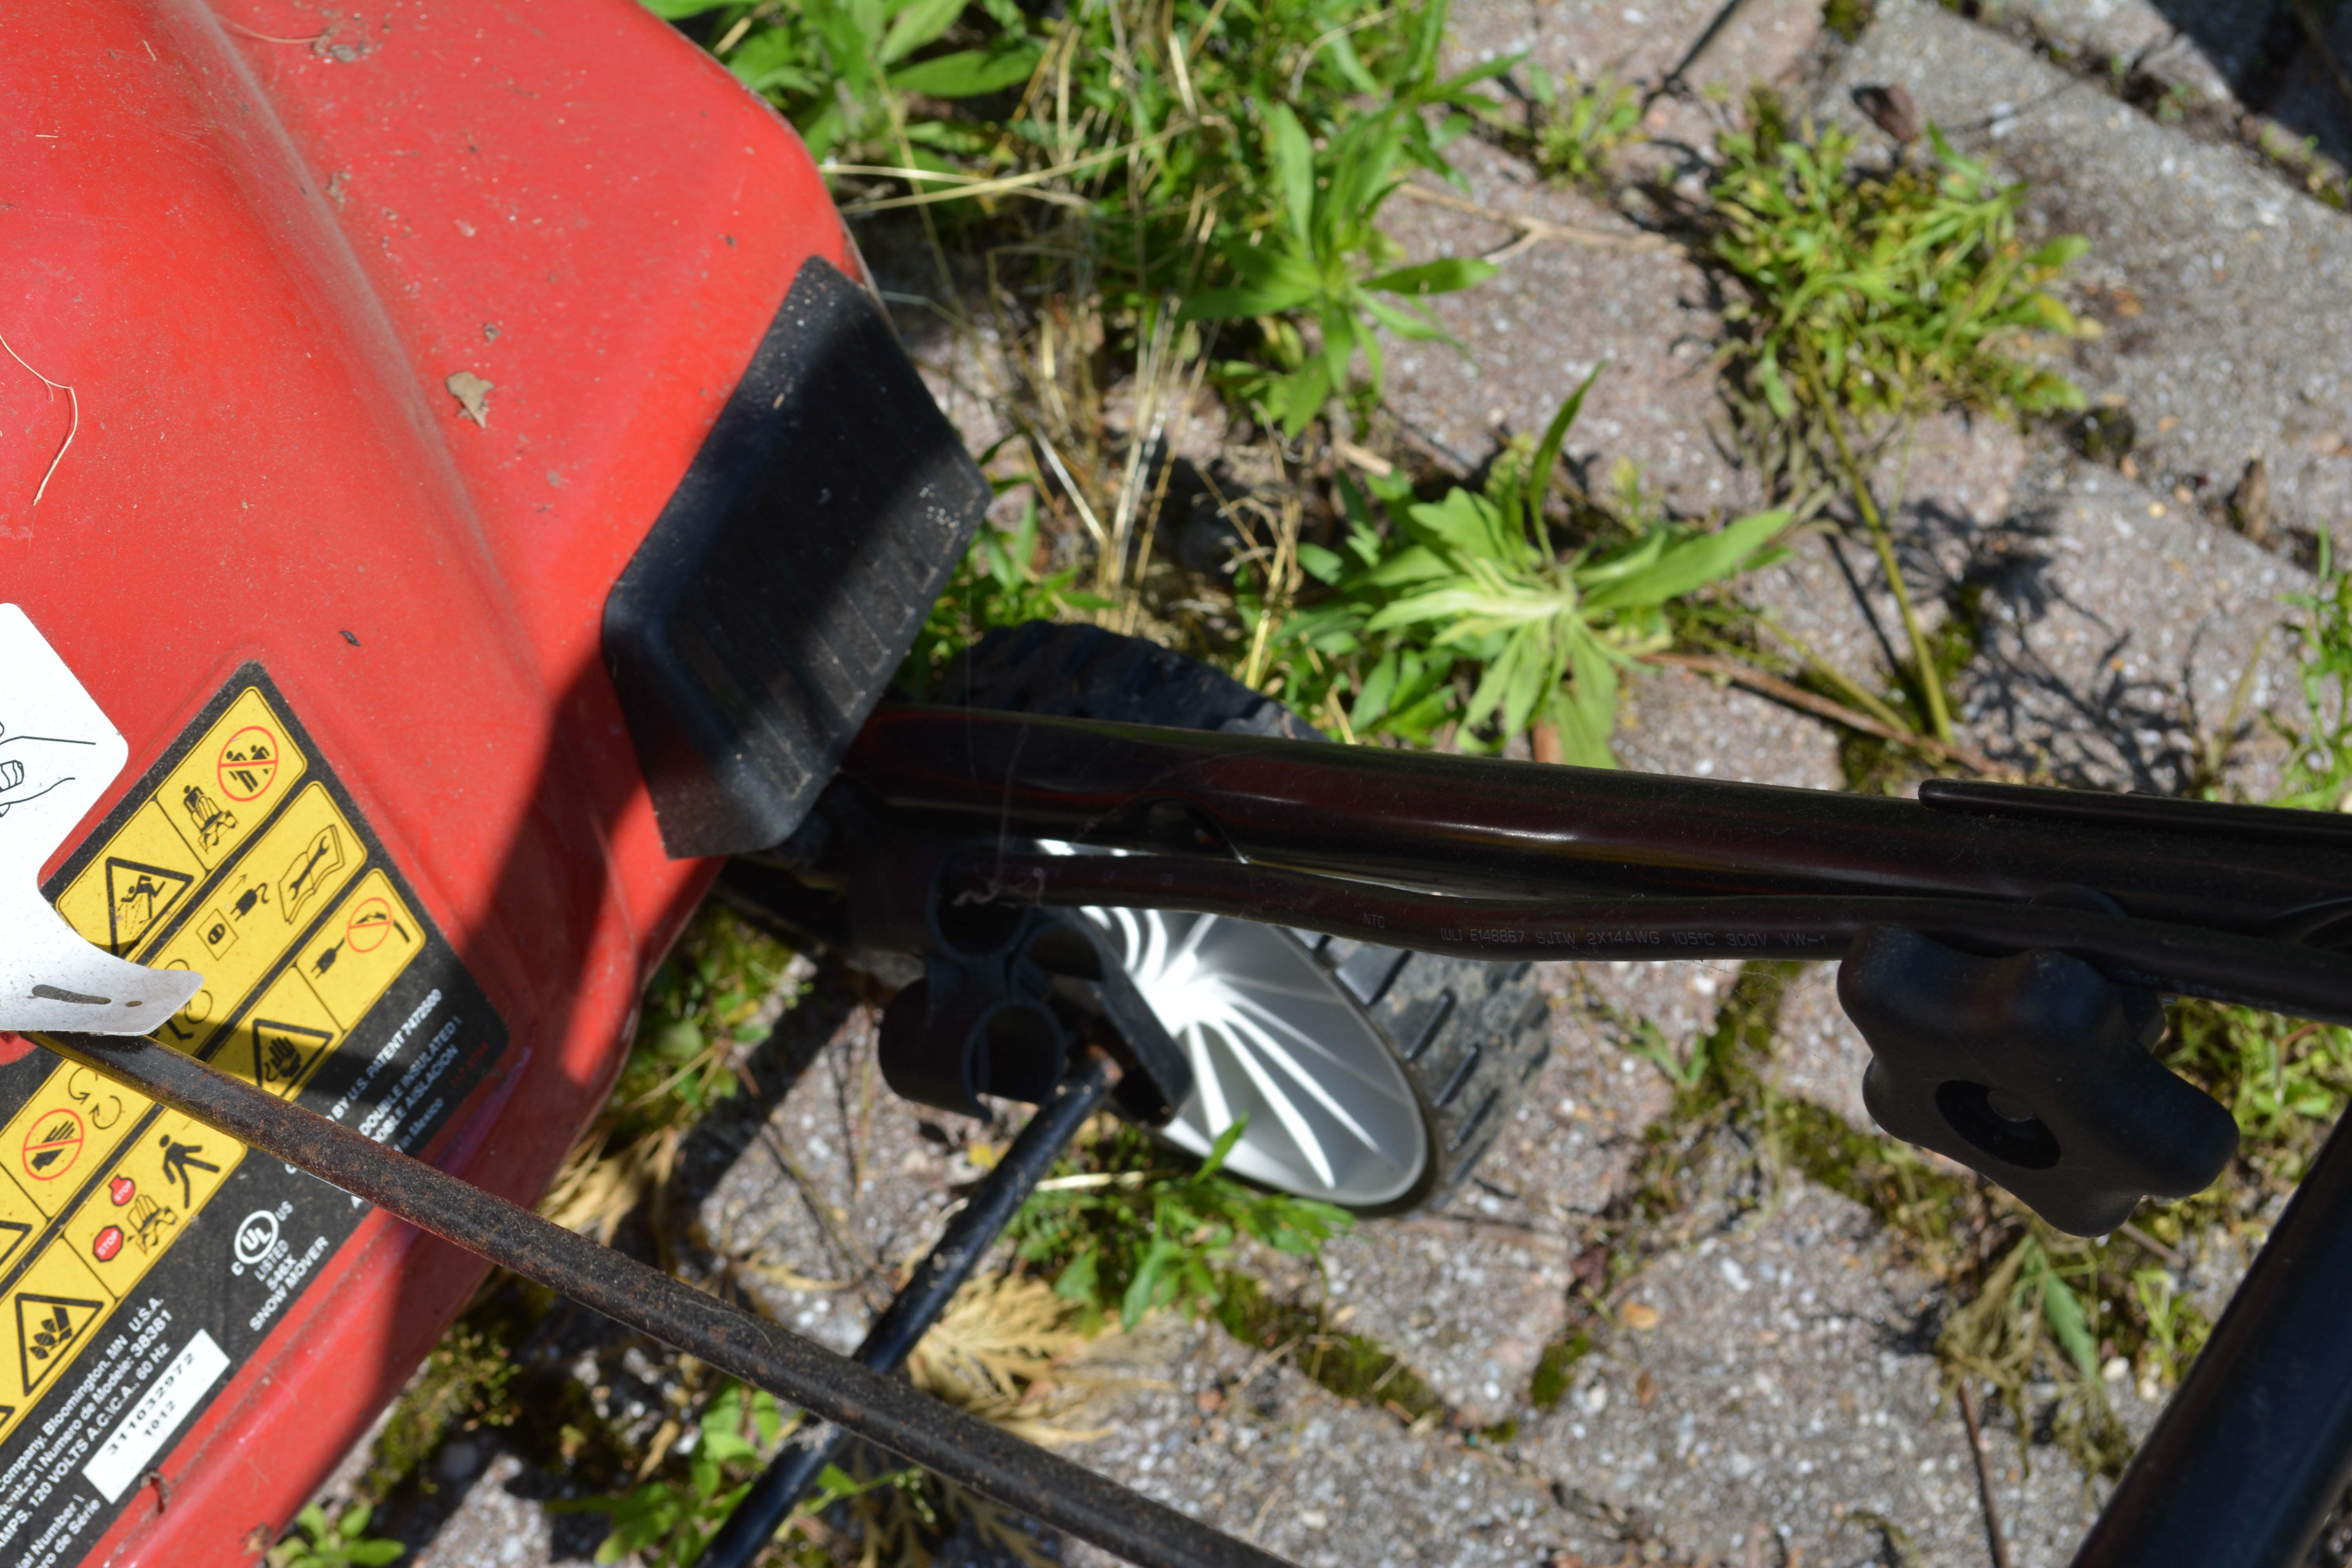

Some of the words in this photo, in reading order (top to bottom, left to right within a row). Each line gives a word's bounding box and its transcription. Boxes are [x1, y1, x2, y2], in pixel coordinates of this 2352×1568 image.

[1363, 912, 1385, 929] NTC
[1470, 928, 1525, 943] E148867
[1535, 931, 1576, 946] SJTW
[1586, 931, 1660, 945] 2X14AWG
[1726, 933, 1767, 947] 300V
[1779, 933, 1828, 950] VW-1
[332, 1096, 350, 1119] BY
[366, 1031, 405, 1078] PATENT
[358, 1084, 403, 1136] DOUBLE
[400, 1022, 456, 1088] INSULATED
[114, 1180, 132, 1201] STOP
[98, 1230, 118, 1256] STOP
[241, 1227, 272, 1250] UL
[275, 1201, 293, 1221] US
[249, 1284, 287, 1331] SNOW
[284, 1236, 329, 1289] MOVER
[254, 1239, 289, 1281] LISTED
[80, 1403, 96, 1420] de
[130, 1309, 173, 1357] 38381
[105, 1334, 129, 1360] MN
[108, 1352, 196, 1455] 311032972
[144, 1400, 176, 1437] 1012
[0, 1510, 33, 1550] MPS,
[29, 1481, 53, 1507] 120
[47, 1439, 89, 1483] VOLTS
[136, 1360, 154, 1380] 60
[150, 1342, 171, 1364] Hz
[30, 1501, 77, 1555] Number
[54, 1534, 72, 1553] de
